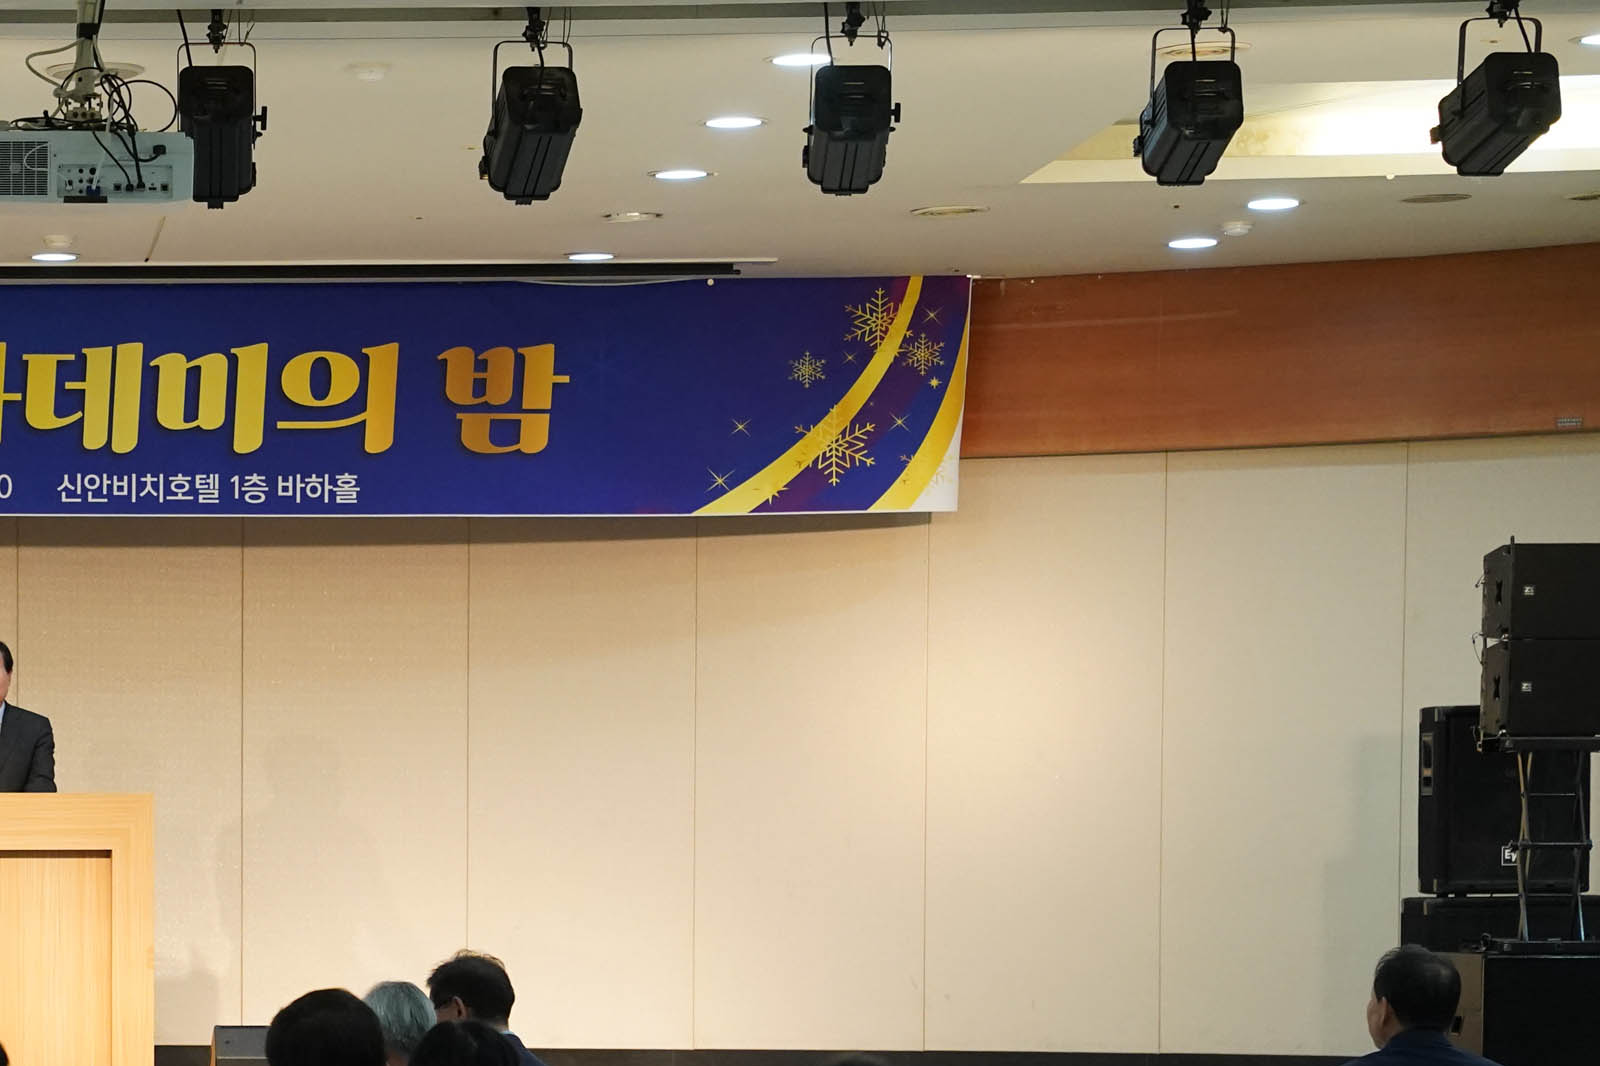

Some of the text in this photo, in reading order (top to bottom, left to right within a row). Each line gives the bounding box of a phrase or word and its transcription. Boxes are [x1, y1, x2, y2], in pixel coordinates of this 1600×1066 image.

[437, 343, 570, 455] 밤
[56, 472, 361, 503] 신안비치호텔 1층 바하홀
